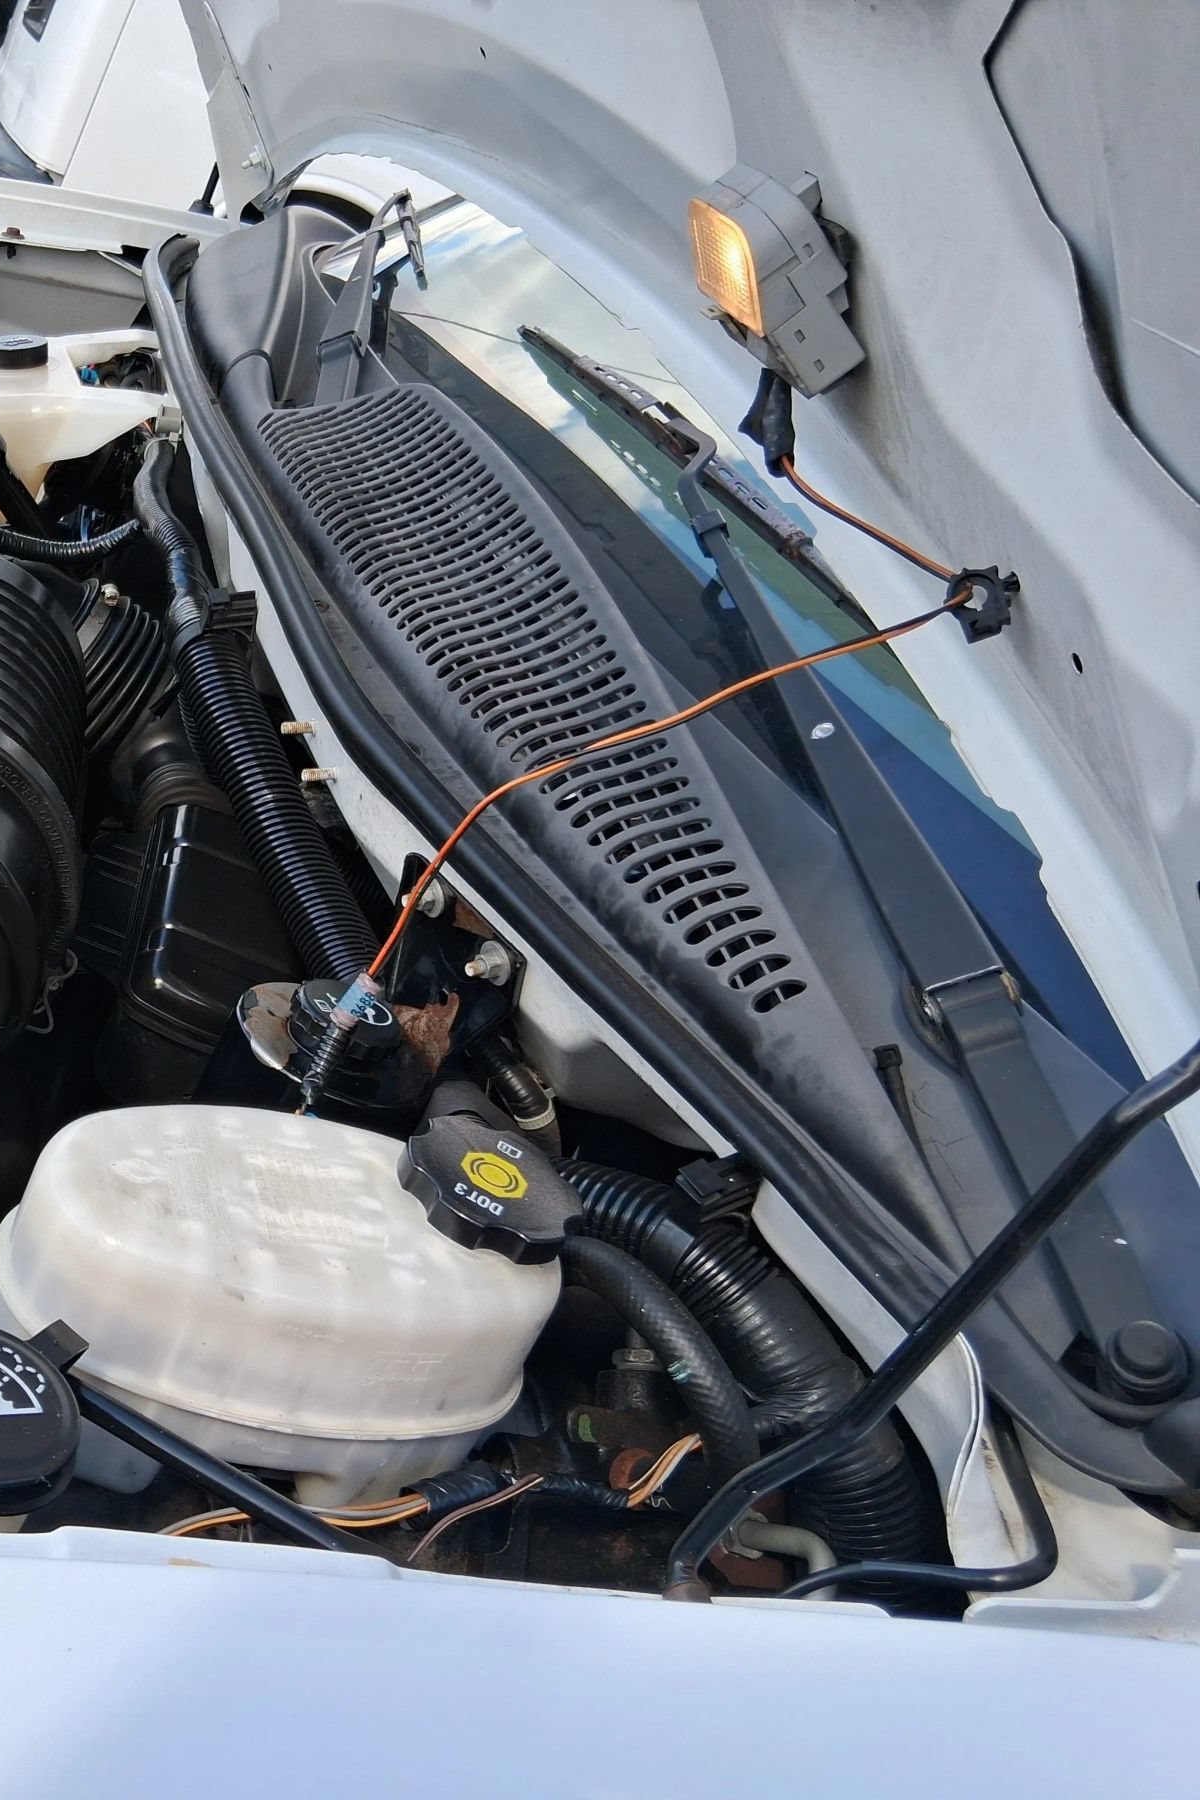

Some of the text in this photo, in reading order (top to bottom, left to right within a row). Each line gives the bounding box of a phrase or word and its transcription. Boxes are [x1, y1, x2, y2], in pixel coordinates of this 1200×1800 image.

[350, 991, 376, 1018] 3688
[454, 1182, 505, 1216] DOT 3
